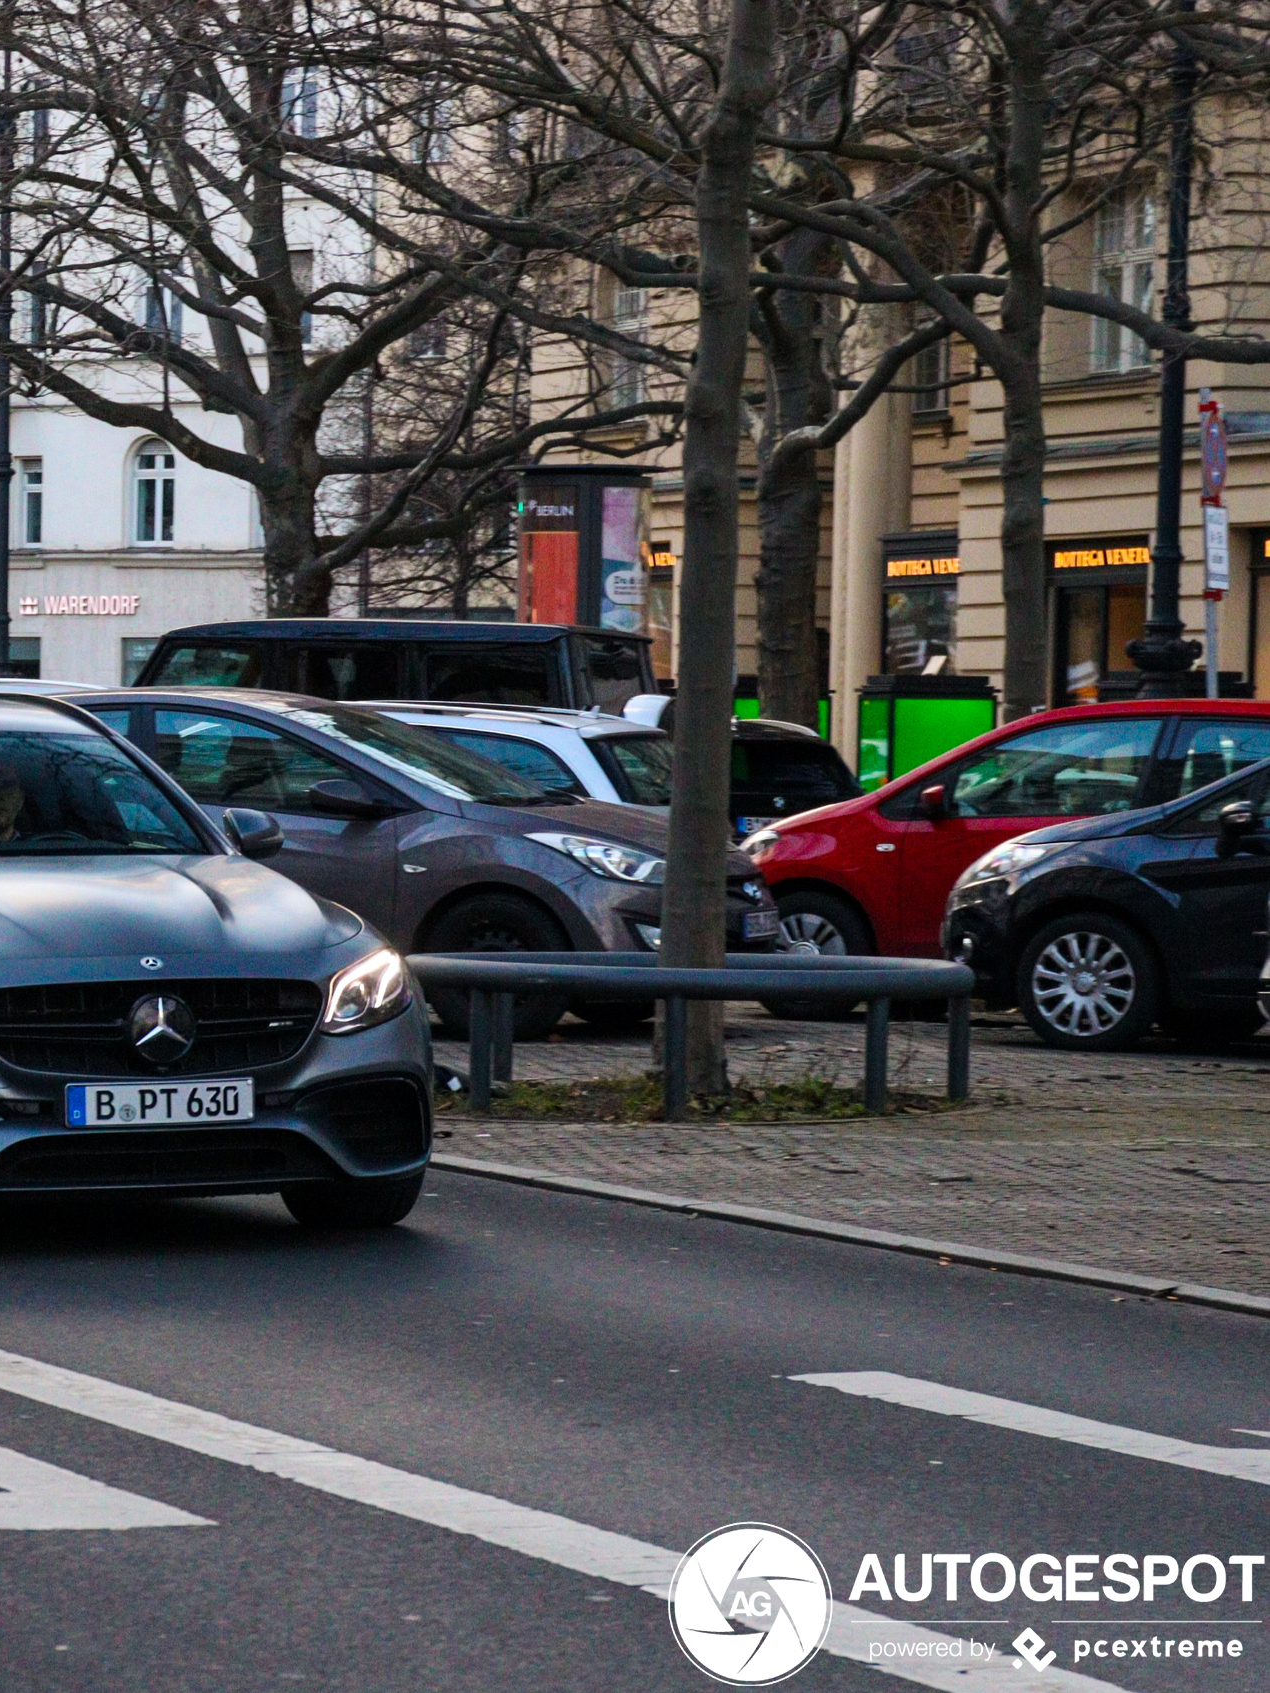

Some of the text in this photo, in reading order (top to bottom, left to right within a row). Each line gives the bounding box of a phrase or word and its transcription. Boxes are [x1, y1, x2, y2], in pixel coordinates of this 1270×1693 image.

[536, 505, 575, 517] BERLIN
[1054, 547, 1150, 569] BOTTEGA VENETA
[887, 560, 932, 577] BOTTEGA
[44, 595, 139, 615] WARENDORF
[95, 1086, 239, 1120] B PT 630
